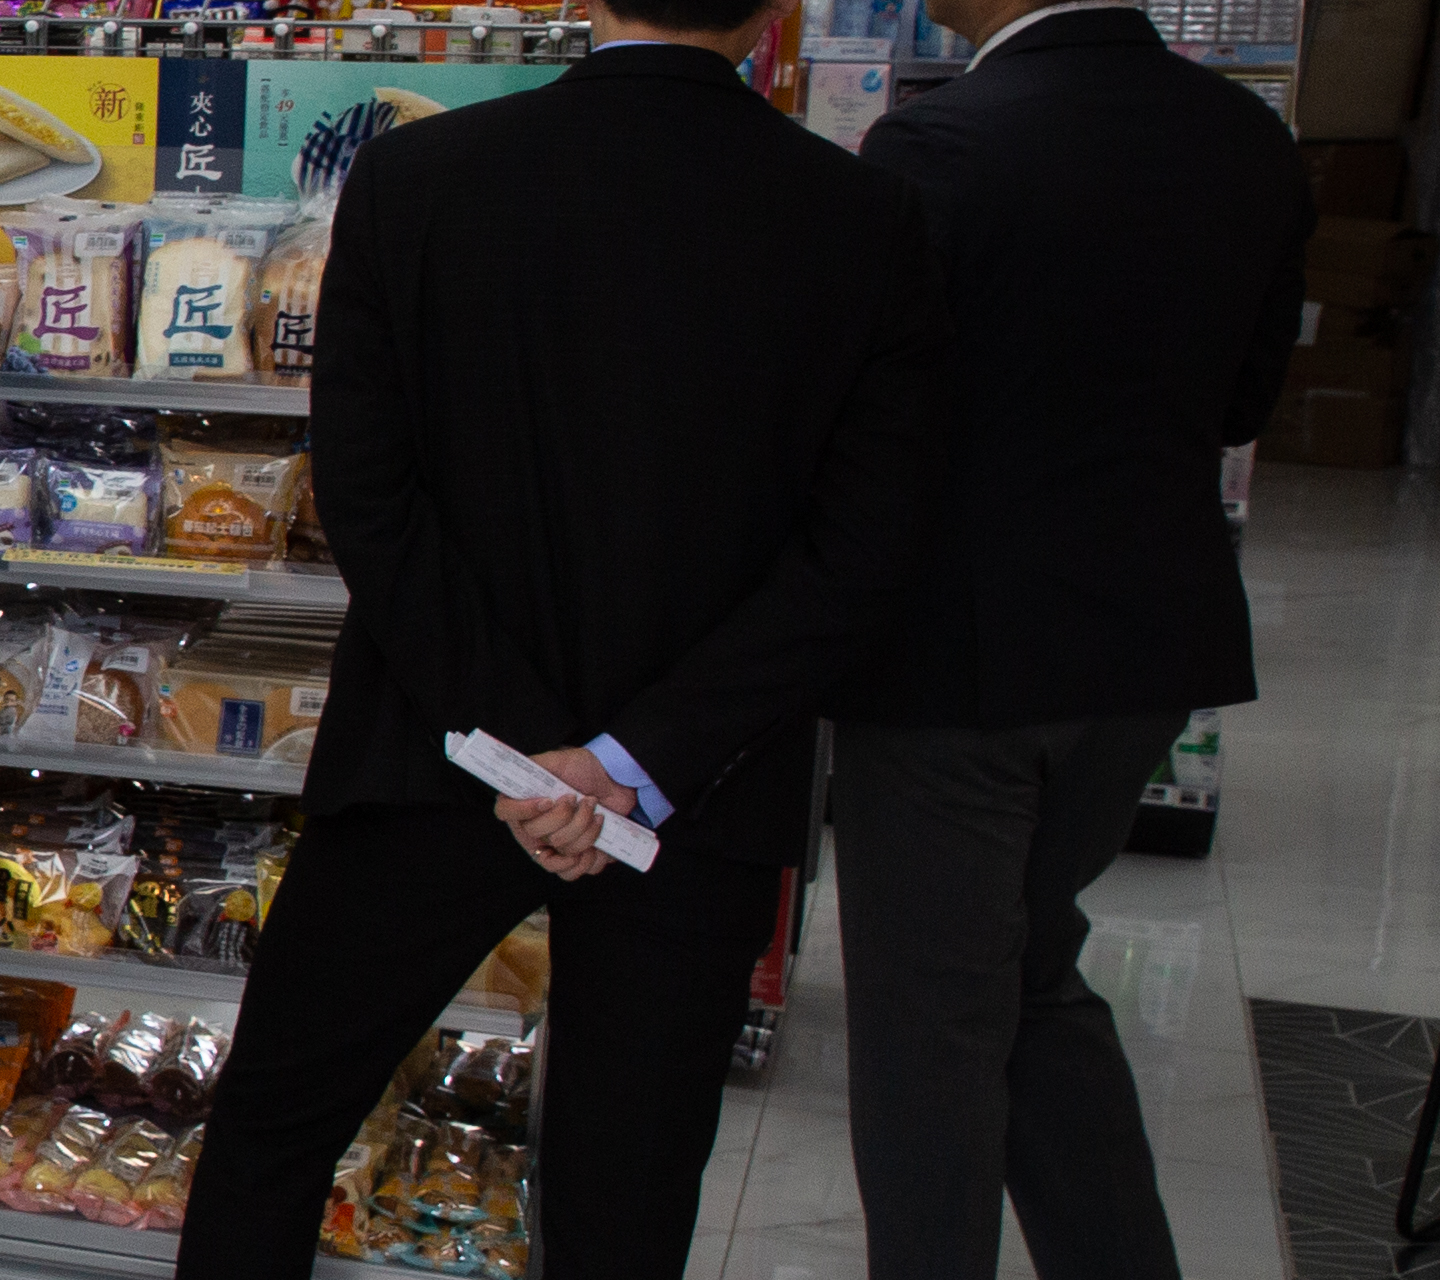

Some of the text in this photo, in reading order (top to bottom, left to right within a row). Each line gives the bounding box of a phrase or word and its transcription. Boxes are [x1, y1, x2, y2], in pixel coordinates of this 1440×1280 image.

[93, 86, 128, 122] 新
[33, 285, 101, 341] 匠
[163, 285, 234, 340] 匠
